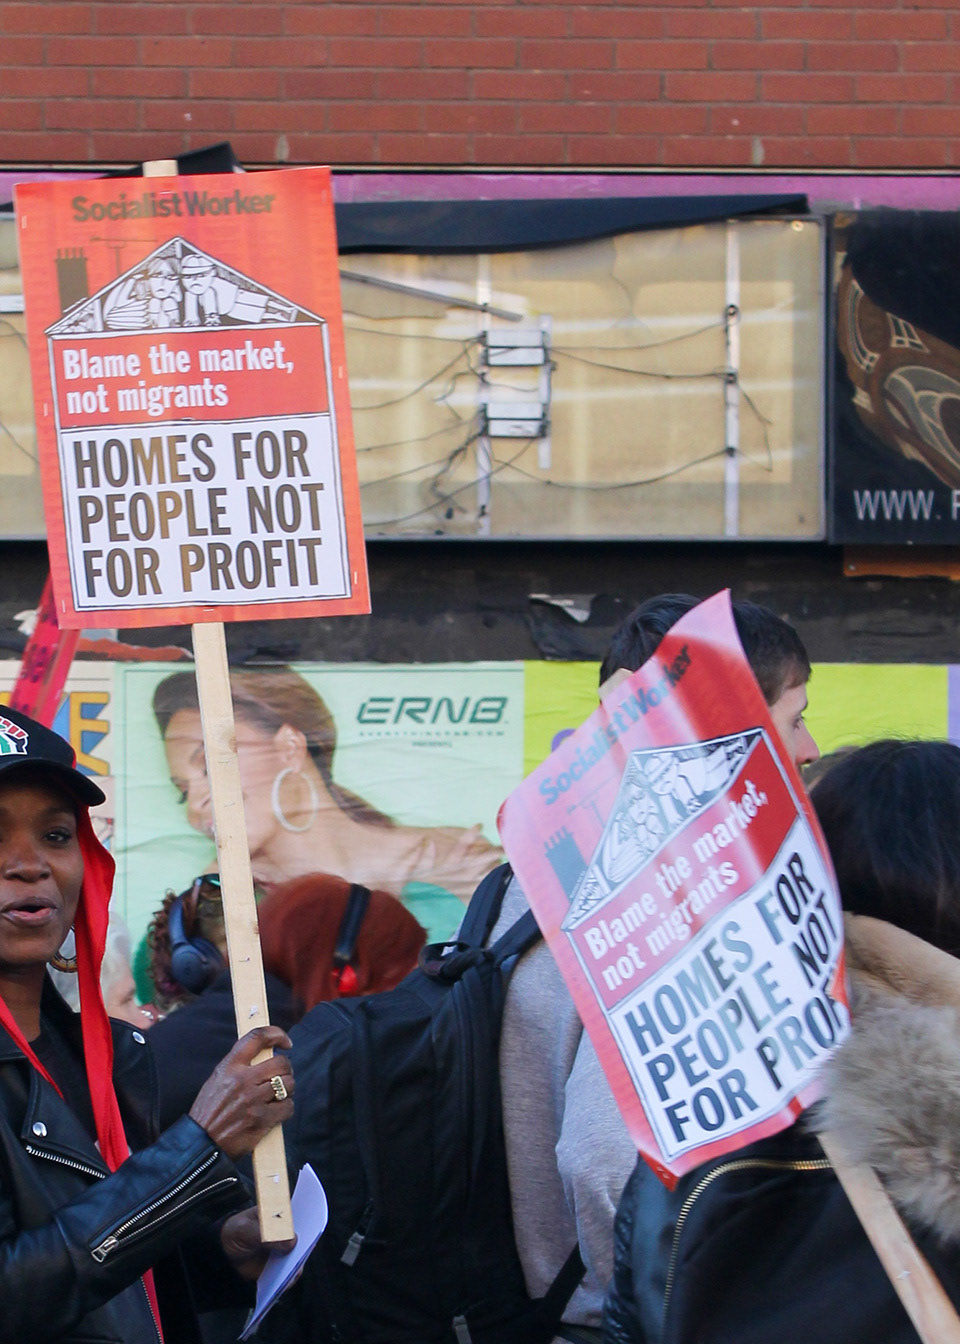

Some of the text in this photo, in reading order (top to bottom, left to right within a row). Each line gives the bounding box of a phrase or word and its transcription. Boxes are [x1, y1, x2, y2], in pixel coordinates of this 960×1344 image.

[62, 340, 294, 380] Blame the market,
[66, 377, 229, 416] not migrants
[73, 430, 311, 489] HOMES FOR
[78, 483, 324, 544] PEOPLE NOT
[84, 537, 322, 598] FOR PROFIT
[356, 696, 509, 725] ERNB
[583, 778, 770, 961] Blame the market,
[601, 862, 739, 992] not migrants
[625, 852, 816, 1056] HOMES FOR
[645, 887, 841, 1102] PEOPLE NOT
[665, 977, 842, 1143] FOR PROF
